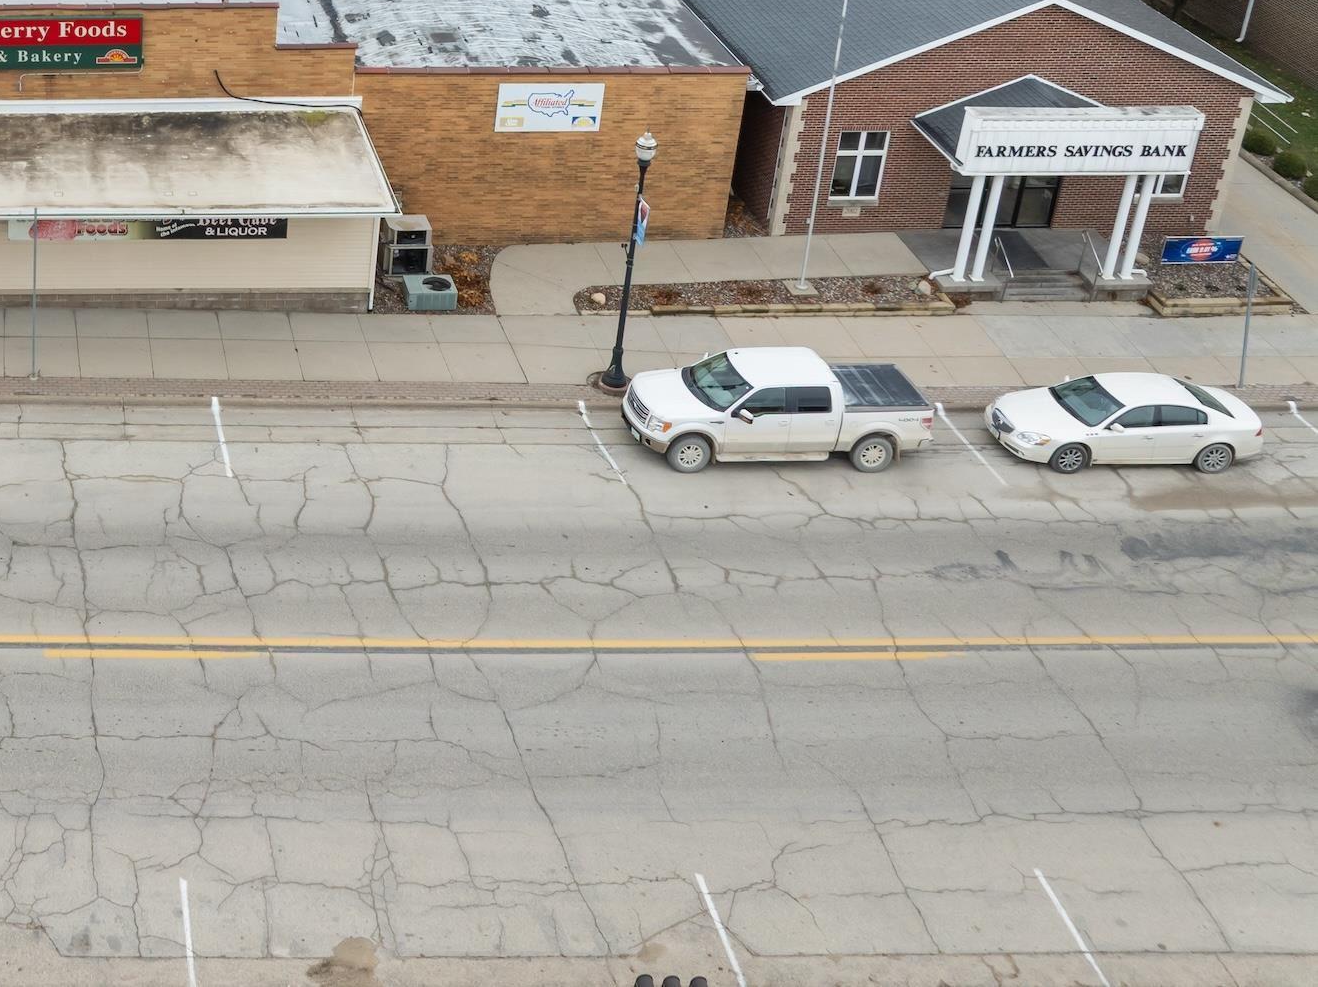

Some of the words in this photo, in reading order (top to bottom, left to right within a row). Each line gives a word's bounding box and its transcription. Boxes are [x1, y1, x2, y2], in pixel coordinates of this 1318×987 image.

[58, 21, 127, 38] Foods
[17, 49, 82, 64] Bakery
[974, 145, 1057, 158] FARMERS
[1064, 144, 1133, 158] SAVINGS
[1140, 144, 1188, 157] BANK
[204, 227, 215, 236] &
[216, 226, 268, 236] LIQUOR
